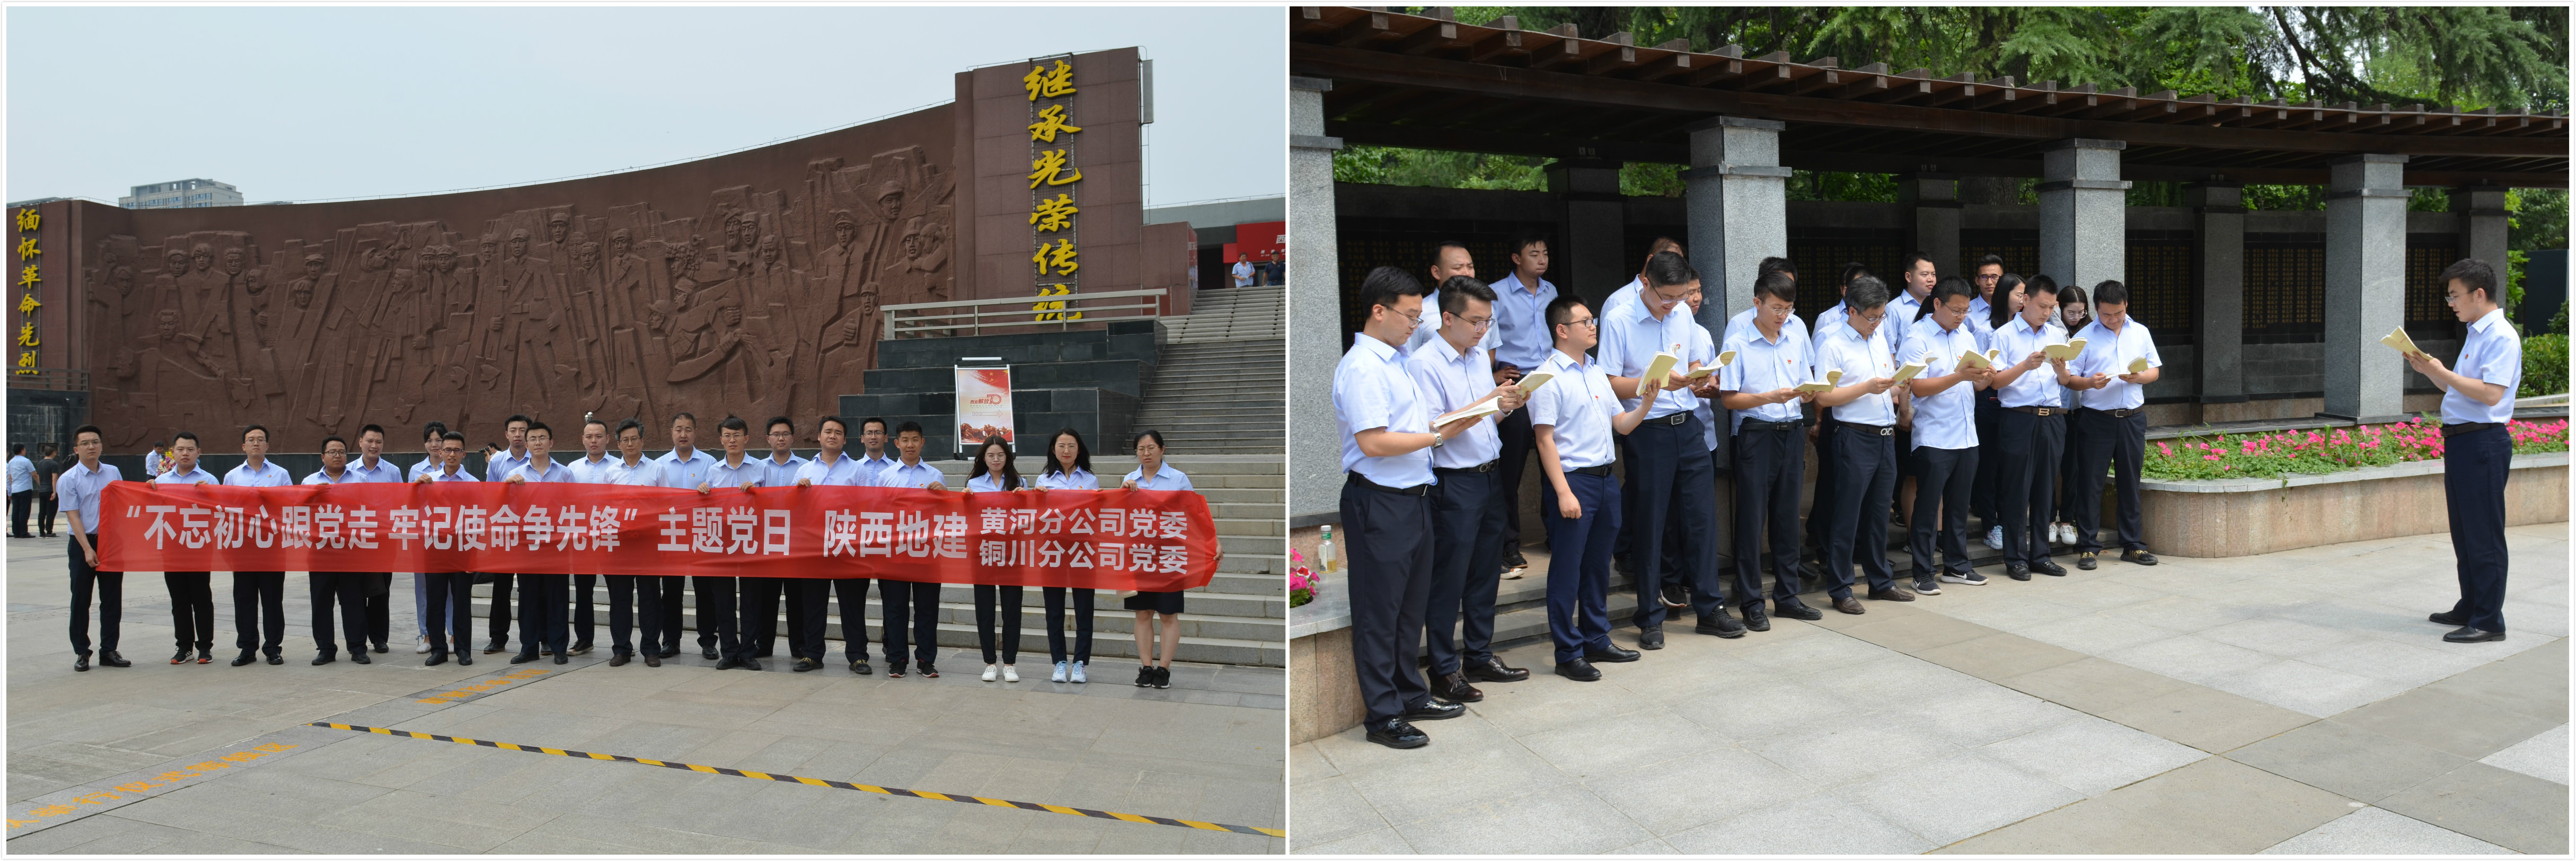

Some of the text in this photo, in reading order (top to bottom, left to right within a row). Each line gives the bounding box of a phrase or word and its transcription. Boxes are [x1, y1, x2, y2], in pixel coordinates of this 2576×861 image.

[1024, 60, 1082, 322] 继承光荣传统
[16, 208, 41, 375] 缅怀革命先烈
[658, 506, 791, 557] 主题党日
[823, 509, 968, 559] 陕西地建
[980, 507, 1188, 540] 黄河分公司党委
[980, 540, 1188, 575] 铜川分公司党委
